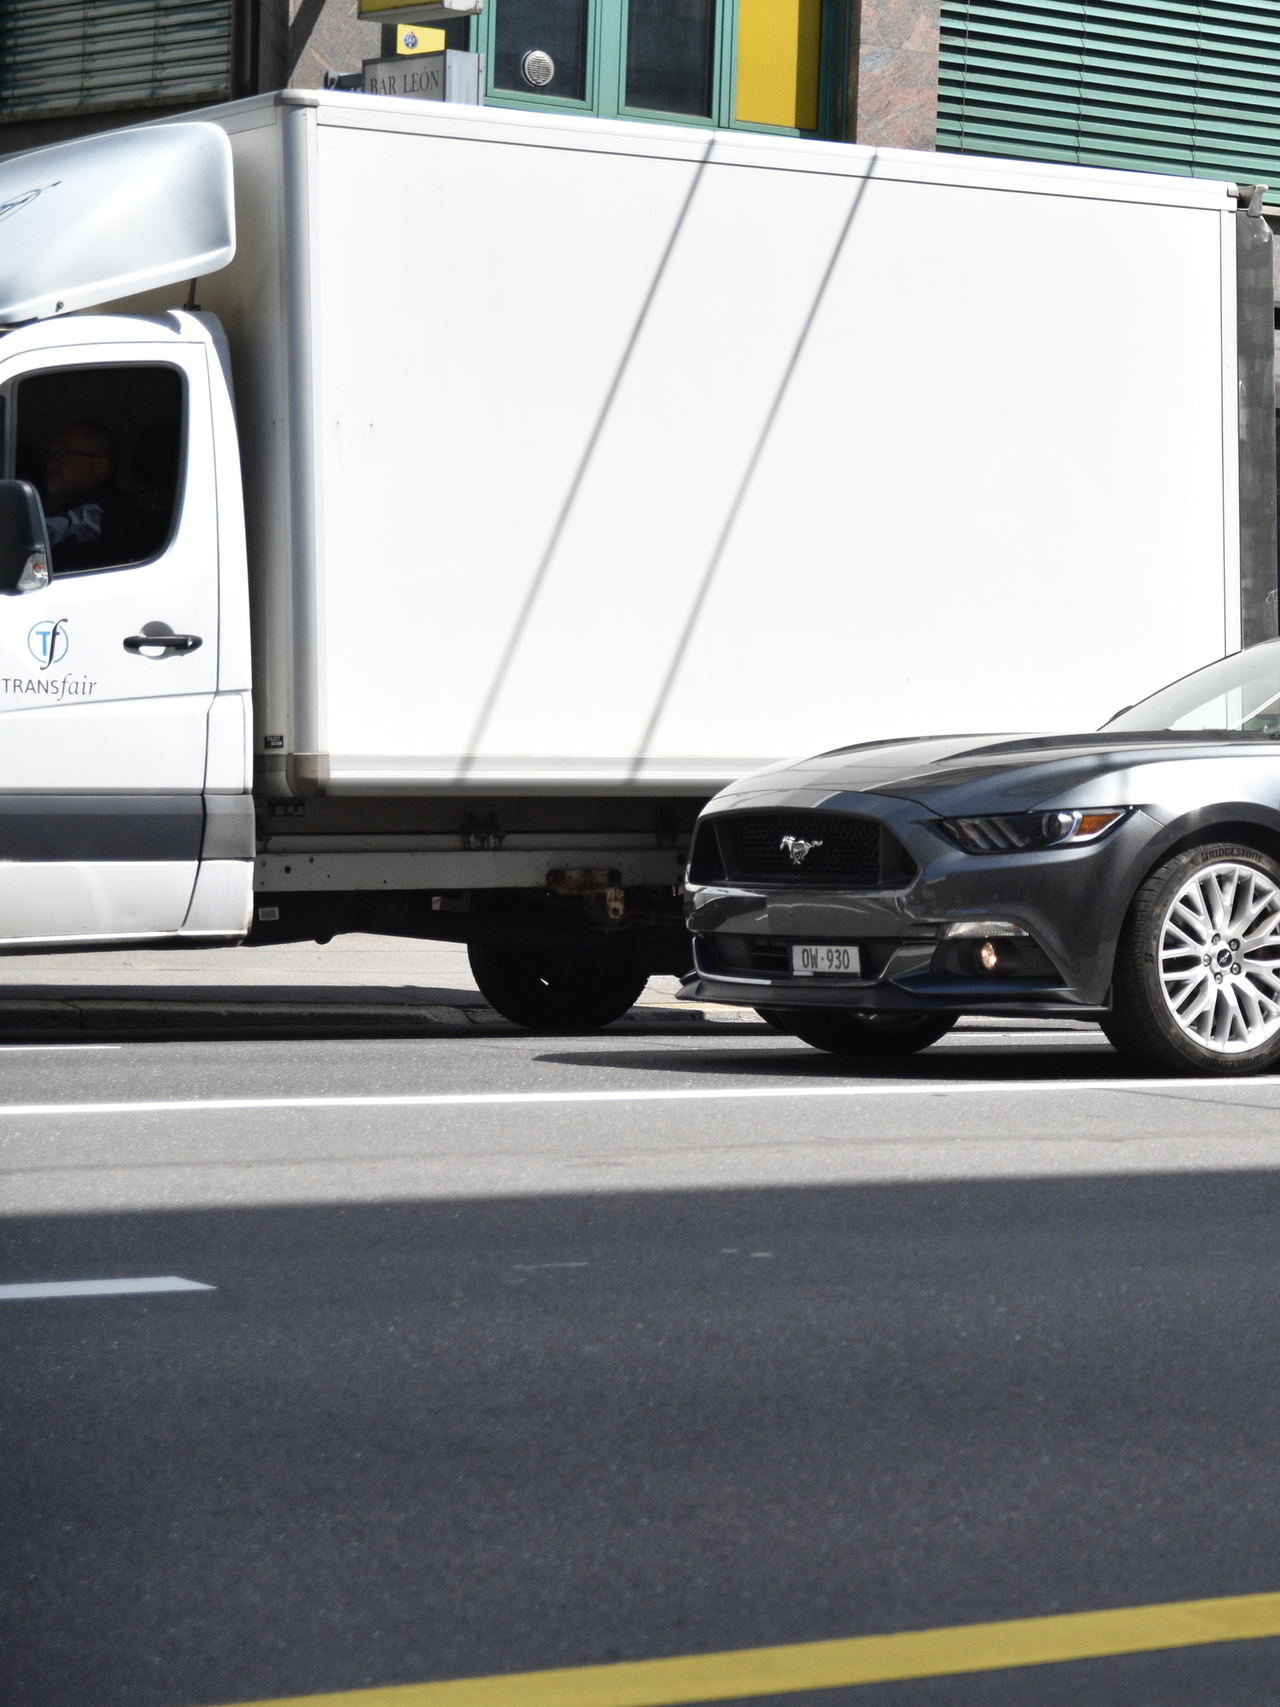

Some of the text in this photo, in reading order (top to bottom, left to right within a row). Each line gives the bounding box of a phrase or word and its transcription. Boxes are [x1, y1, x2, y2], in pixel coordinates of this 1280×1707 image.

[370, 66, 440, 95] BAR LEÓN
[2, 672, 97, 701] TRANSfair
